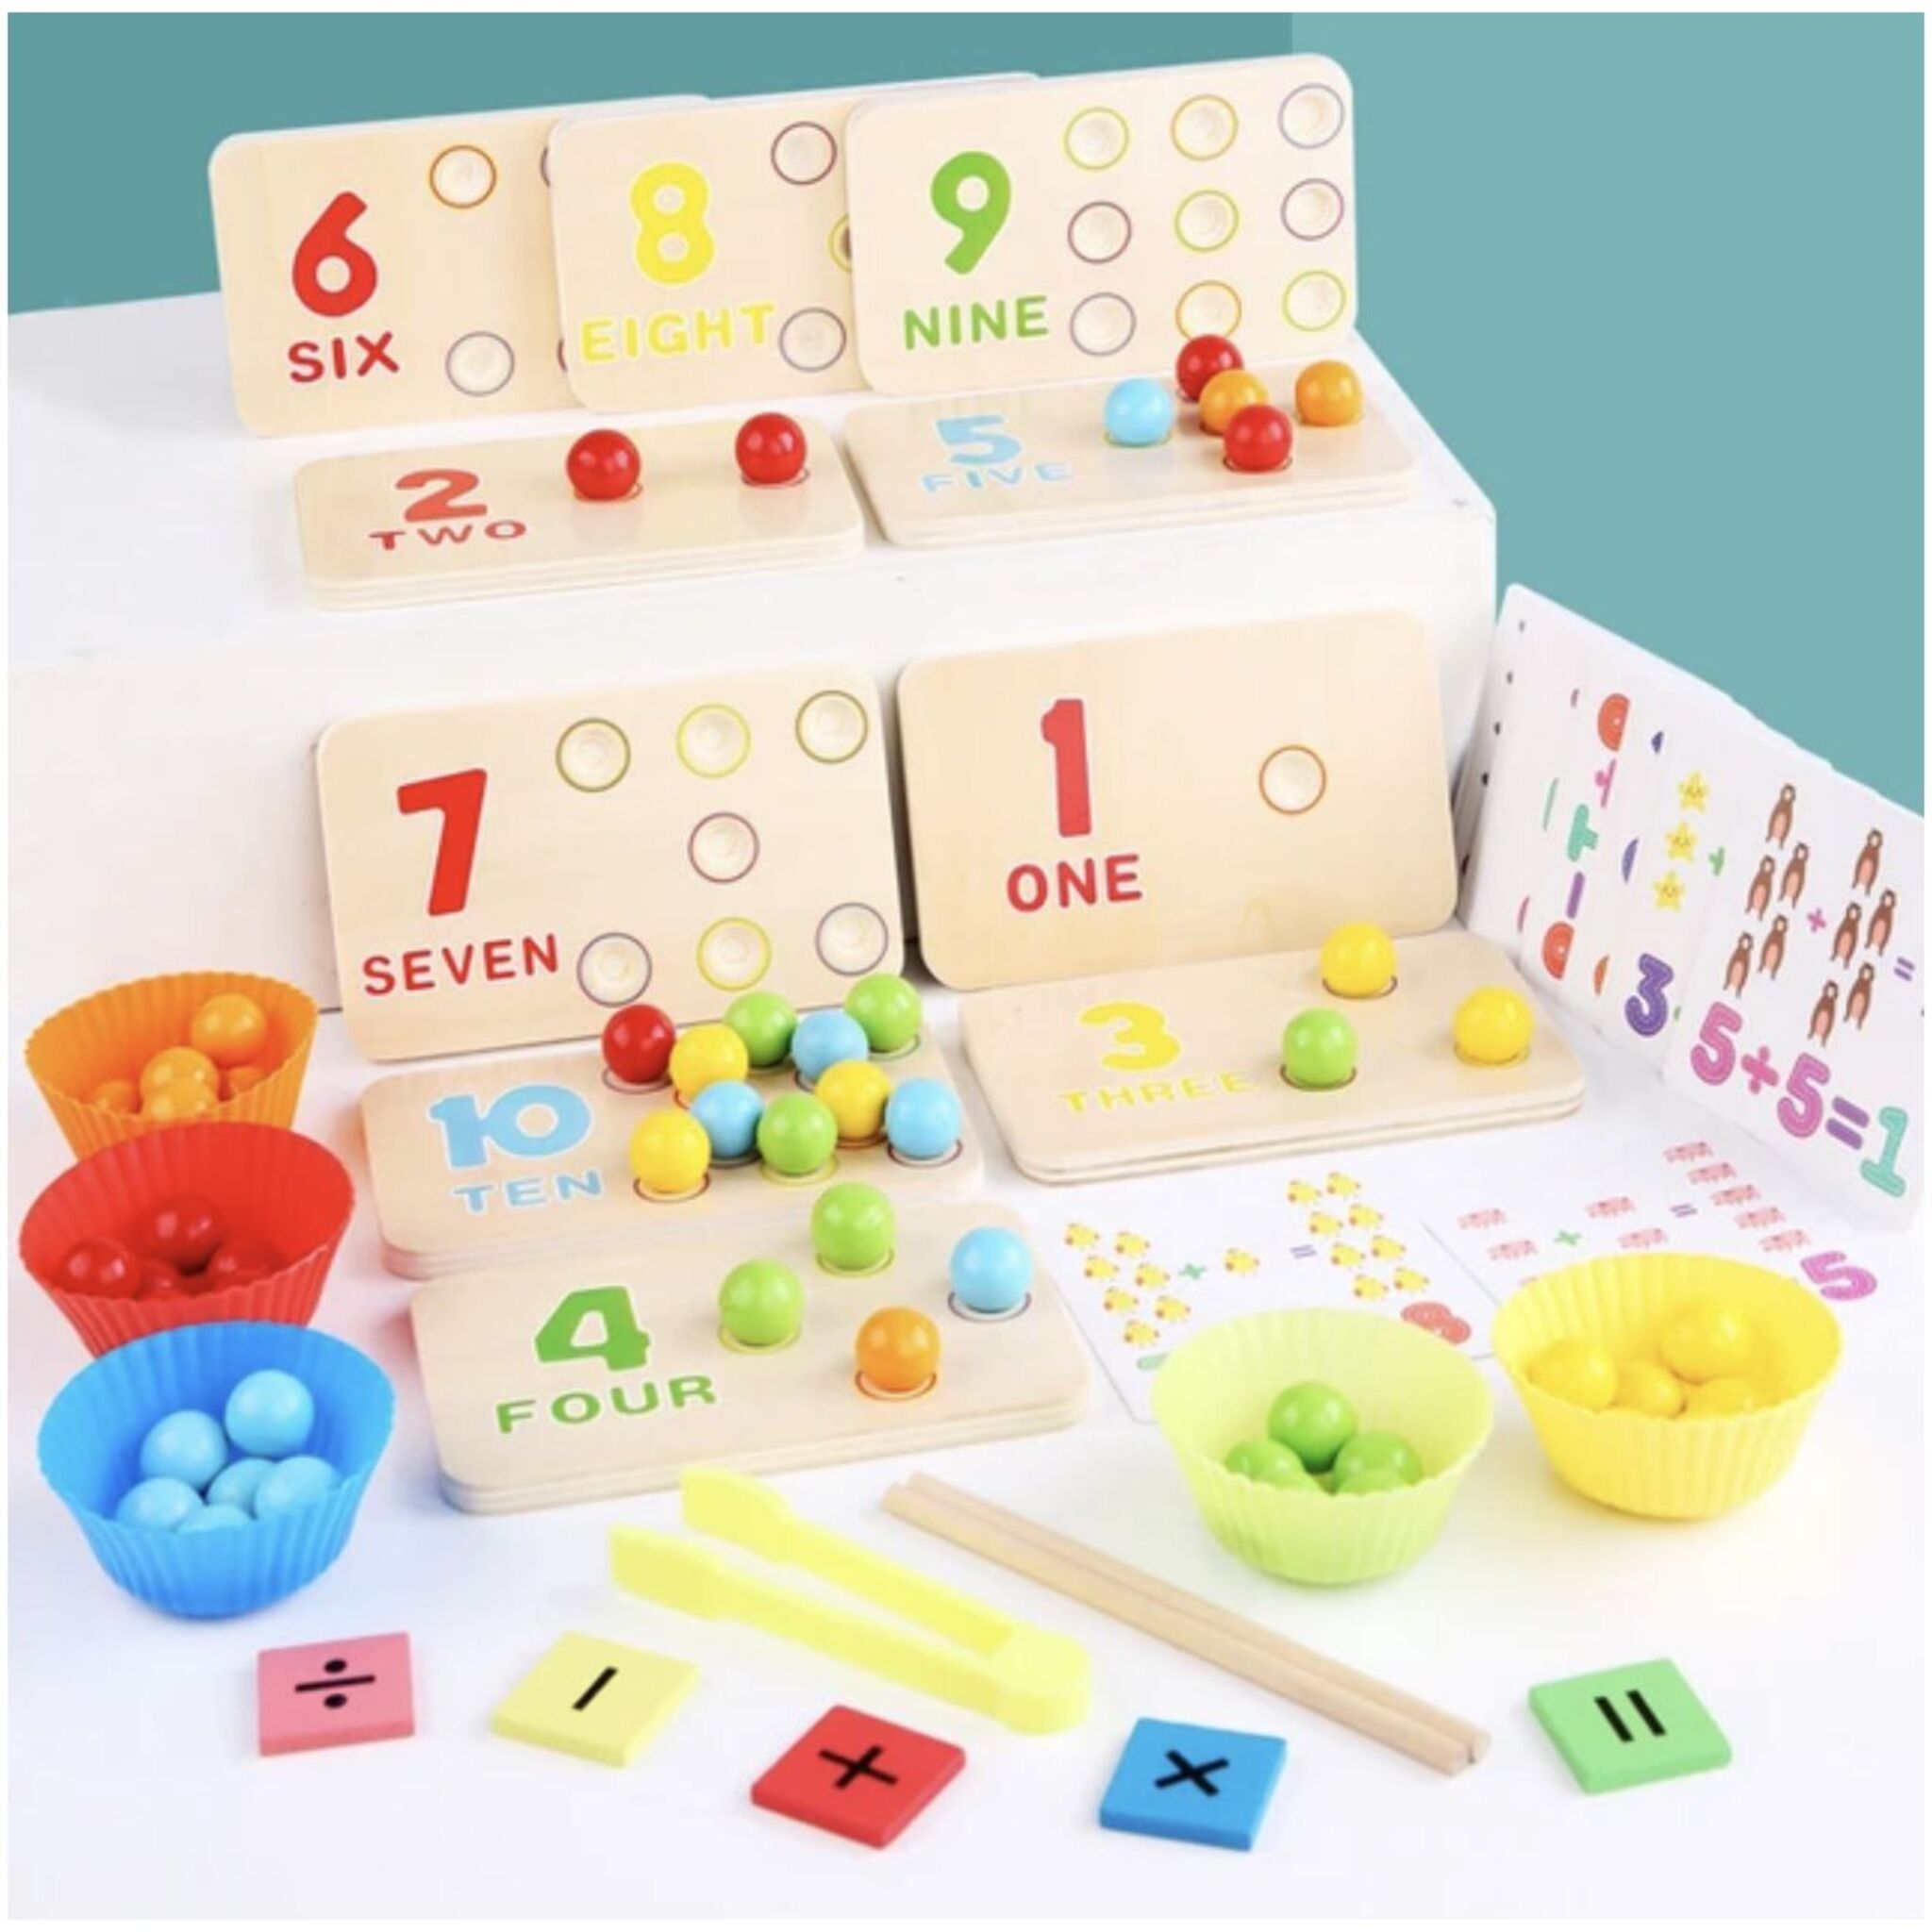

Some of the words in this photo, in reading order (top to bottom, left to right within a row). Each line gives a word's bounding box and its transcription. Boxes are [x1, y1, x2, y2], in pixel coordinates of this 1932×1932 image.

[628, 160, 716, 287] 8
[929, 150, 1012, 275] 9
[291, 192, 378, 318] 6
[579, 302, 776, 363] EIGHT
[903, 295, 1049, 350] NINE
[287, 331, 399, 383] SIX
[936, 415, 1022, 464] 5
[395, 468, 488, 523] 2
[921, 461, 1074, 493] FIVE
[369, 519, 526, 551] TWO
[1041, 699, 1092, 838] 1
[396, 768, 488, 917] 7
[1006, 854, 1143, 913] ONE
[362, 934, 558, 996] SEVEN
[1624, 953, 1674, 1038] 3
[1079, 1001, 1181, 1072] 3
[1058, 1071, 1255, 1114] THREE
[428, 1084, 591, 1169] 10
[452, 1168, 603, 1213] TEN
[1800, 1250, 1878, 1301] 5
[534, 1286, 651, 1372] 4
[495, 1374, 717, 1434] FOUR
